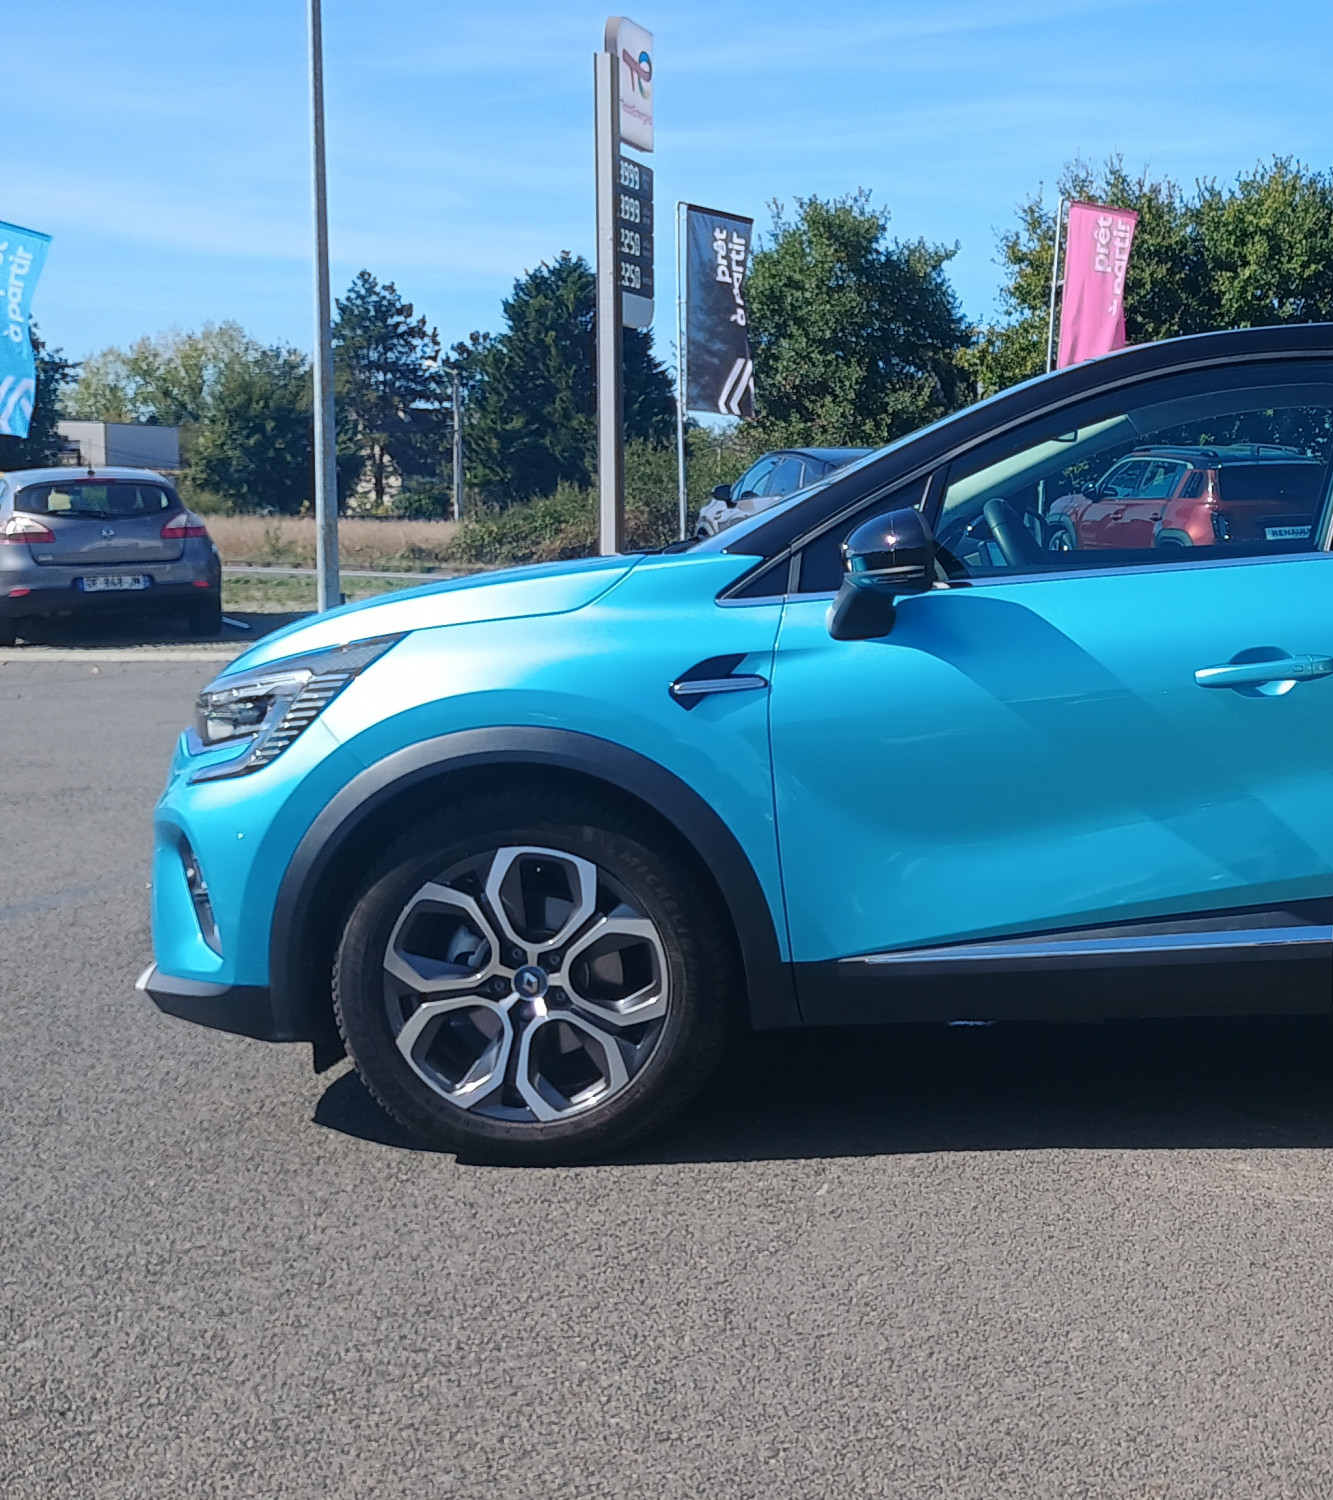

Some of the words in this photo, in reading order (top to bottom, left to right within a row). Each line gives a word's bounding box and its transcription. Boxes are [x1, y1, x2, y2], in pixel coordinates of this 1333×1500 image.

[712, 226, 732, 284] prêt
[1094, 215, 1113, 274] prêt
[8, 246, 34, 323] partir
